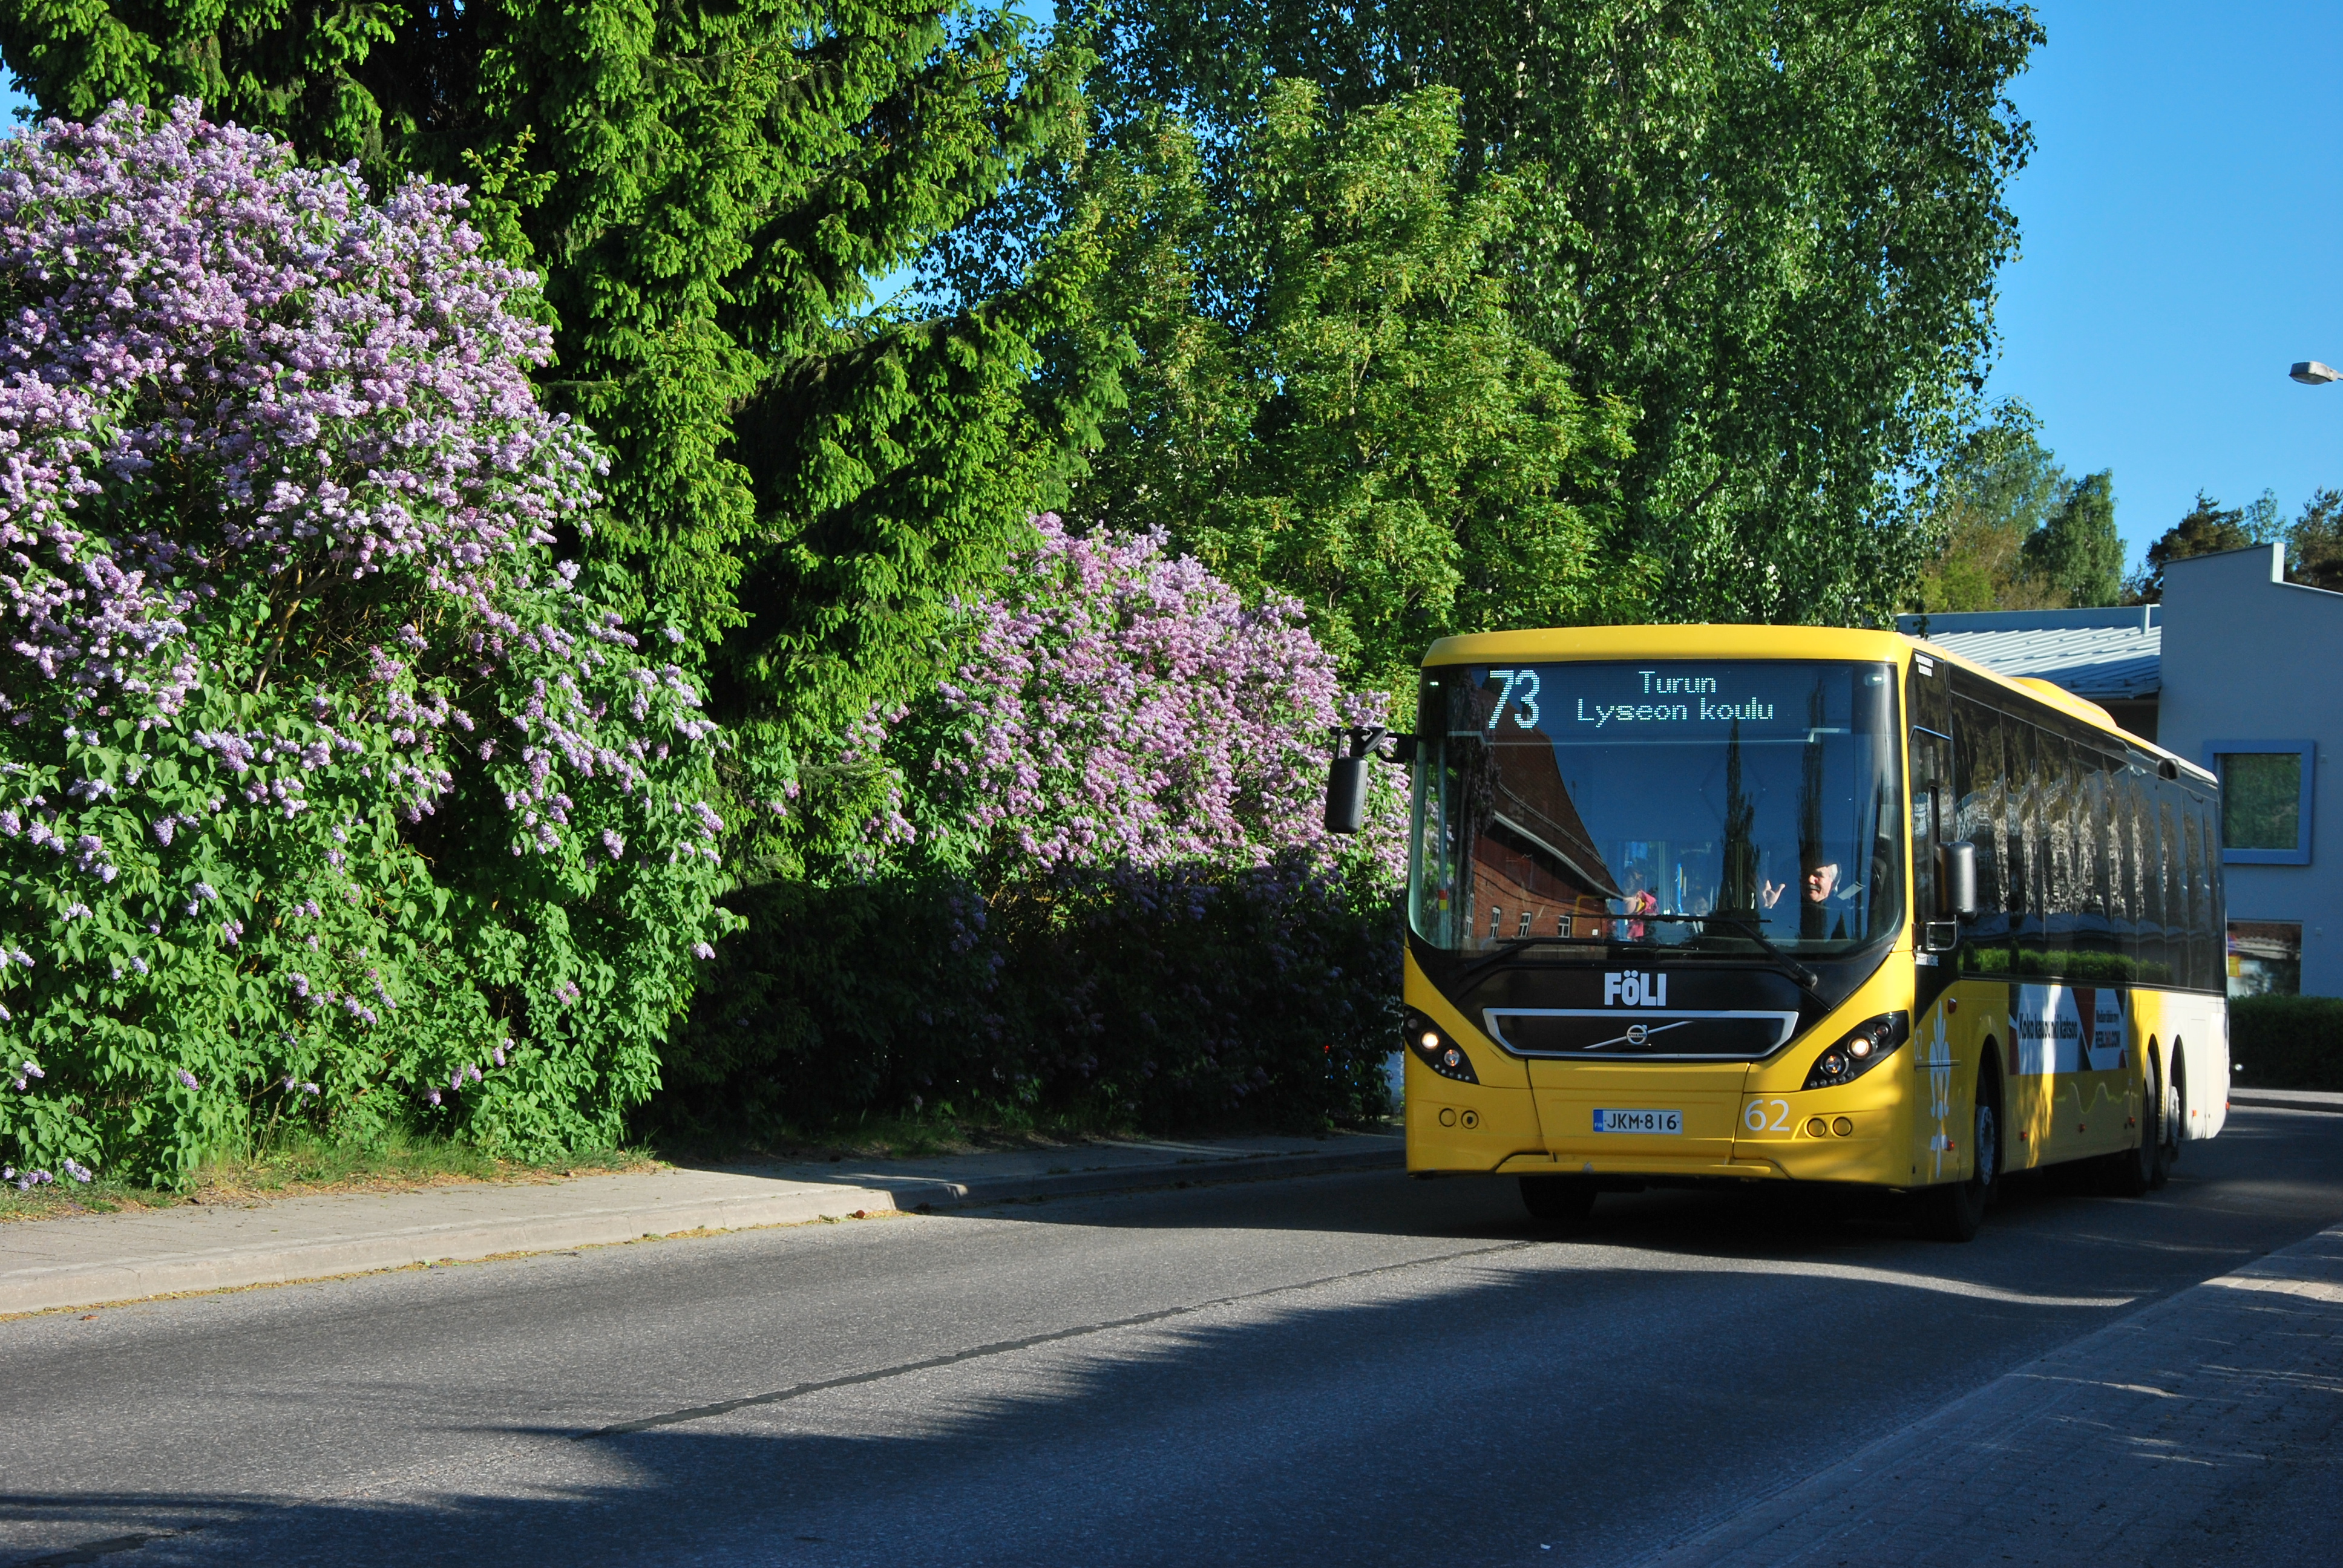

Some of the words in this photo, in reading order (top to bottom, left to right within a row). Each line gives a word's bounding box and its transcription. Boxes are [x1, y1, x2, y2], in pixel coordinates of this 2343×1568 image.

[1639, 671, 1716, 694] Turun
[1489, 670, 1540, 728] 73
[1578, 698, 1688, 728] Lyseon
[1700, 697, 1773, 720] koulu
[1604, 970, 1666, 1007] FÖLI
[2019, 1013, 2034, 1040] Koko
[1607, 1113, 1677, 1130] JKM-816
[1744, 1099, 1790, 1131] 62
